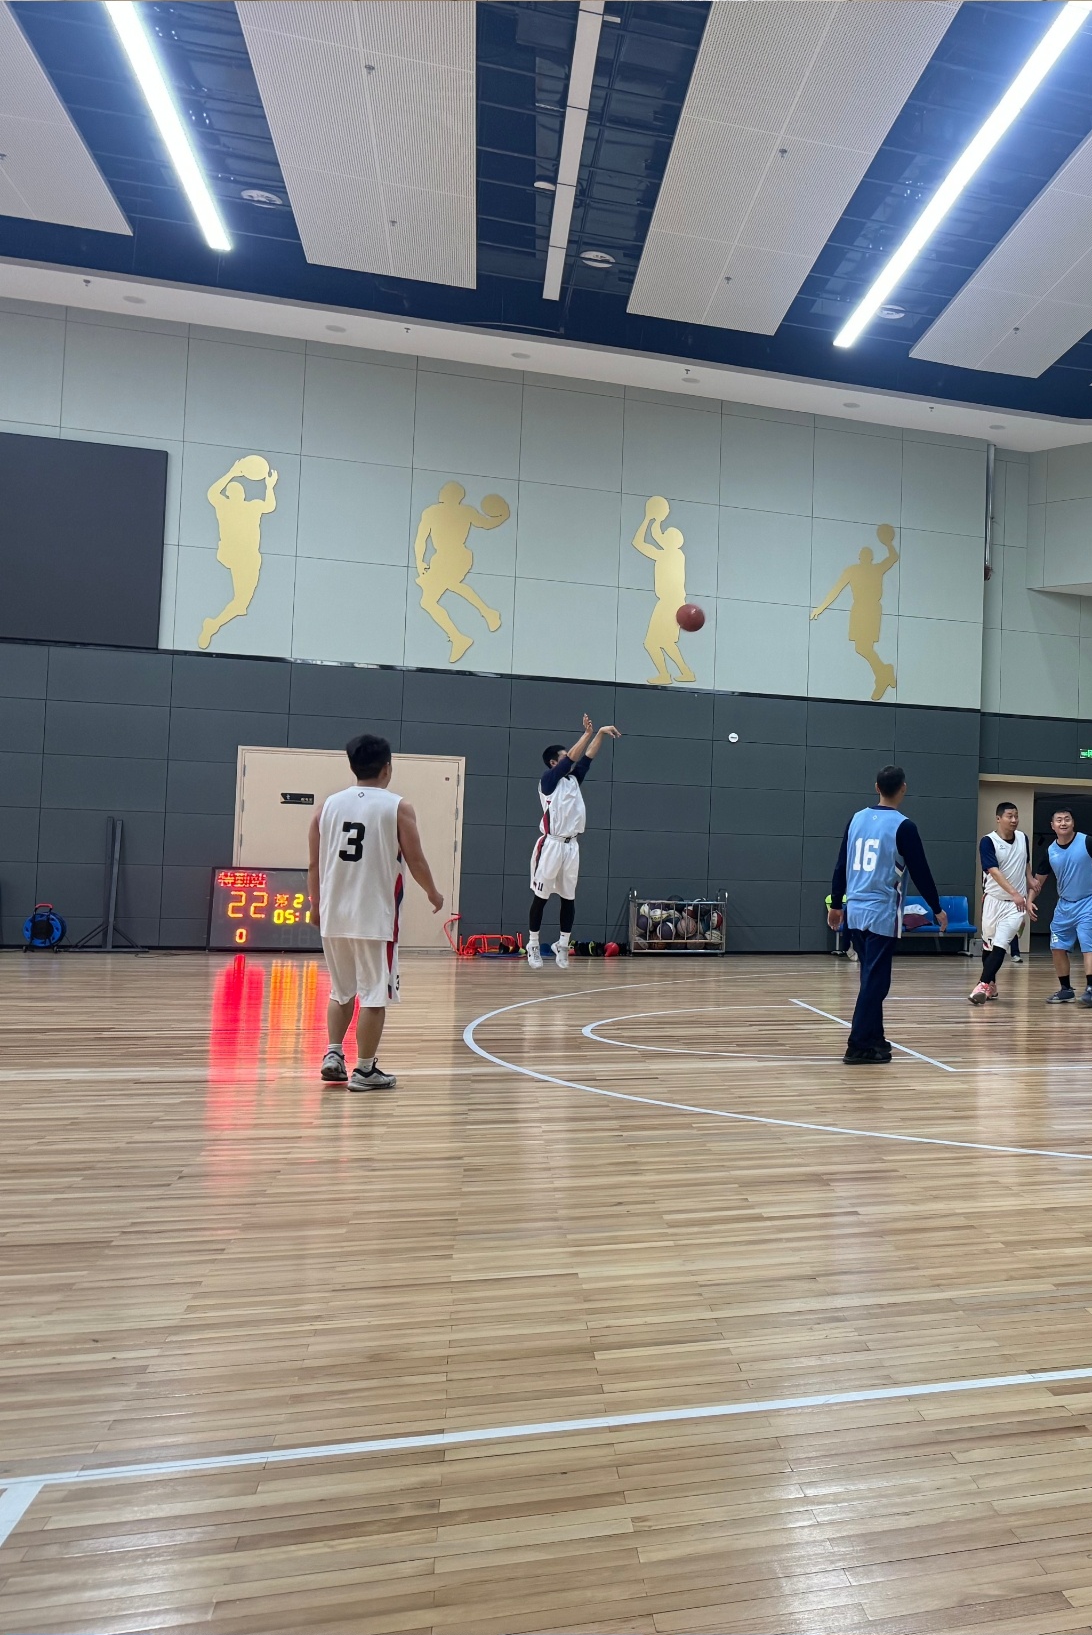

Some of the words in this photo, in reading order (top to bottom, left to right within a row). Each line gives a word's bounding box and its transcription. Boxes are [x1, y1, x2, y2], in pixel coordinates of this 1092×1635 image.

[338, 821, 366, 863] 3
[852, 837, 880, 872] 16
[228, 891, 269, 919] 22
[273, 910, 311, 924] 05:1
[235, 929, 247, 943] 0
